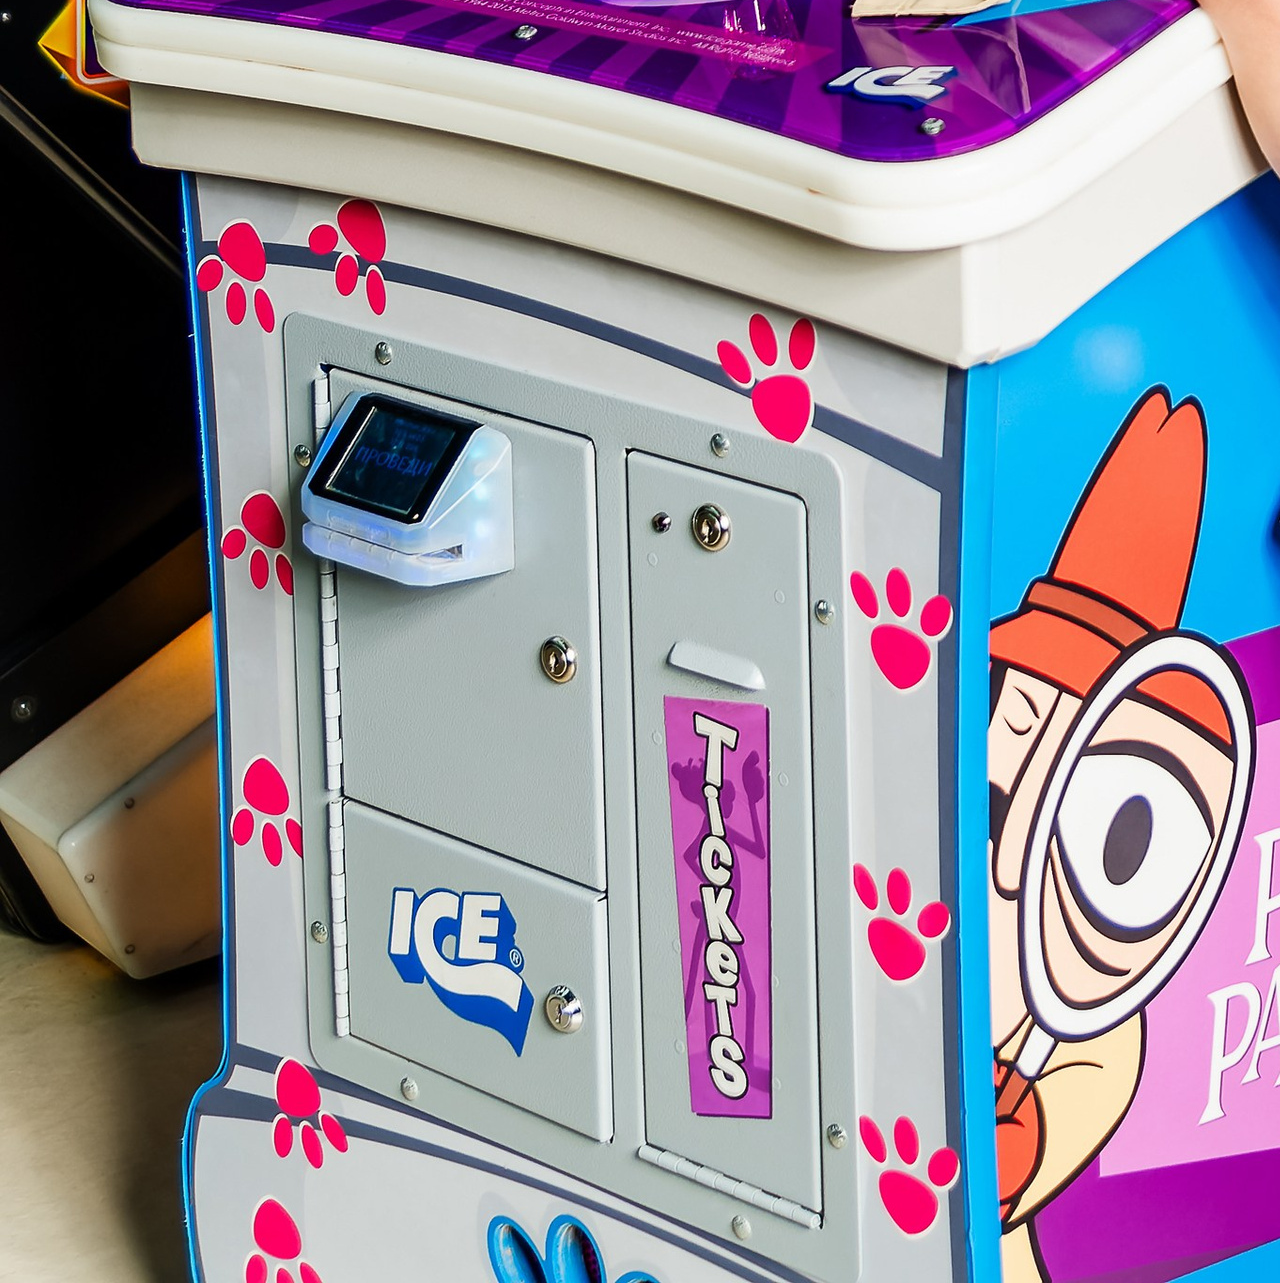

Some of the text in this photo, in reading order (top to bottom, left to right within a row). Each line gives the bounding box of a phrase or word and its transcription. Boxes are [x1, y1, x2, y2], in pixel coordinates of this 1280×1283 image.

[826, 64, 957, 105] ICE
[353, 444, 434, 478] ПРОВЕДИ
[387, 886, 526, 1020] ICE
